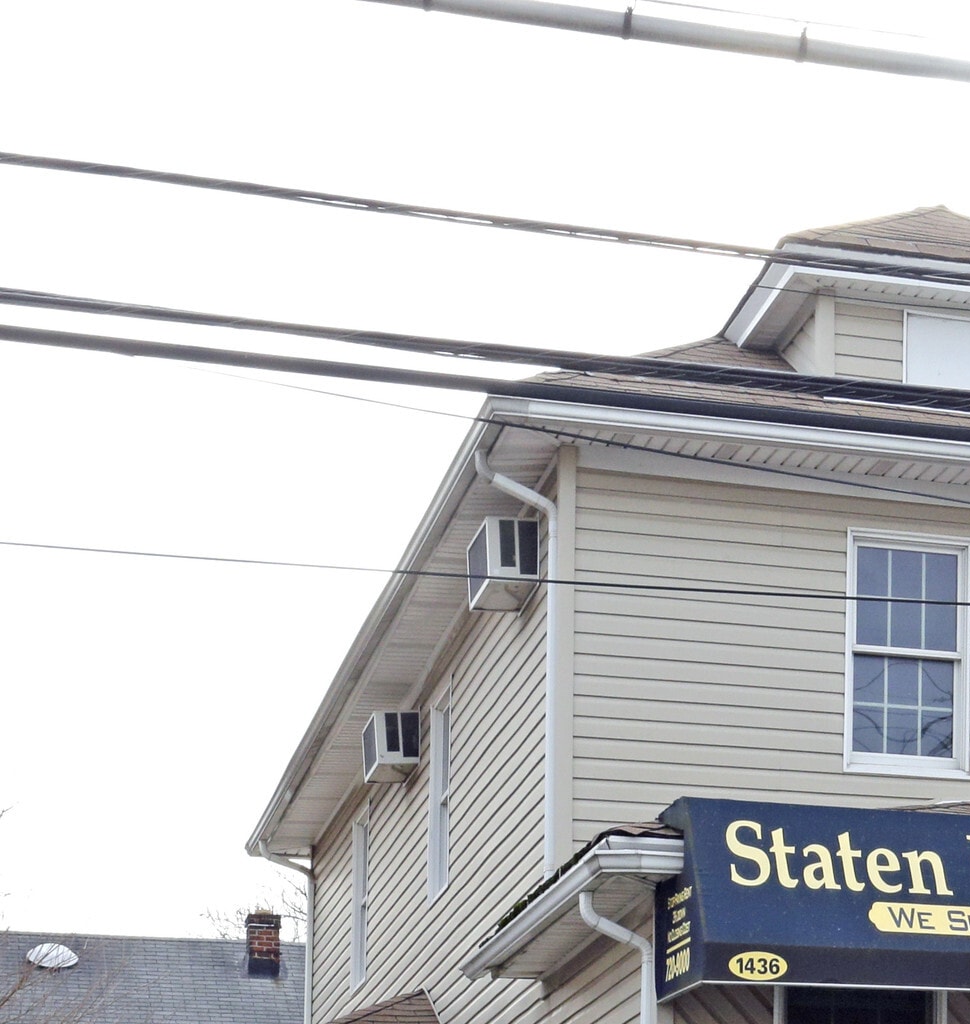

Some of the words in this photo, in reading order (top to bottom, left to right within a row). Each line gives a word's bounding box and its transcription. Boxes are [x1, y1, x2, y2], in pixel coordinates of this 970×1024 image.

[725, 819, 953, 896] Staten
[887, 906, 935, 930] WE
[735, 957, 781, 975] 1436
